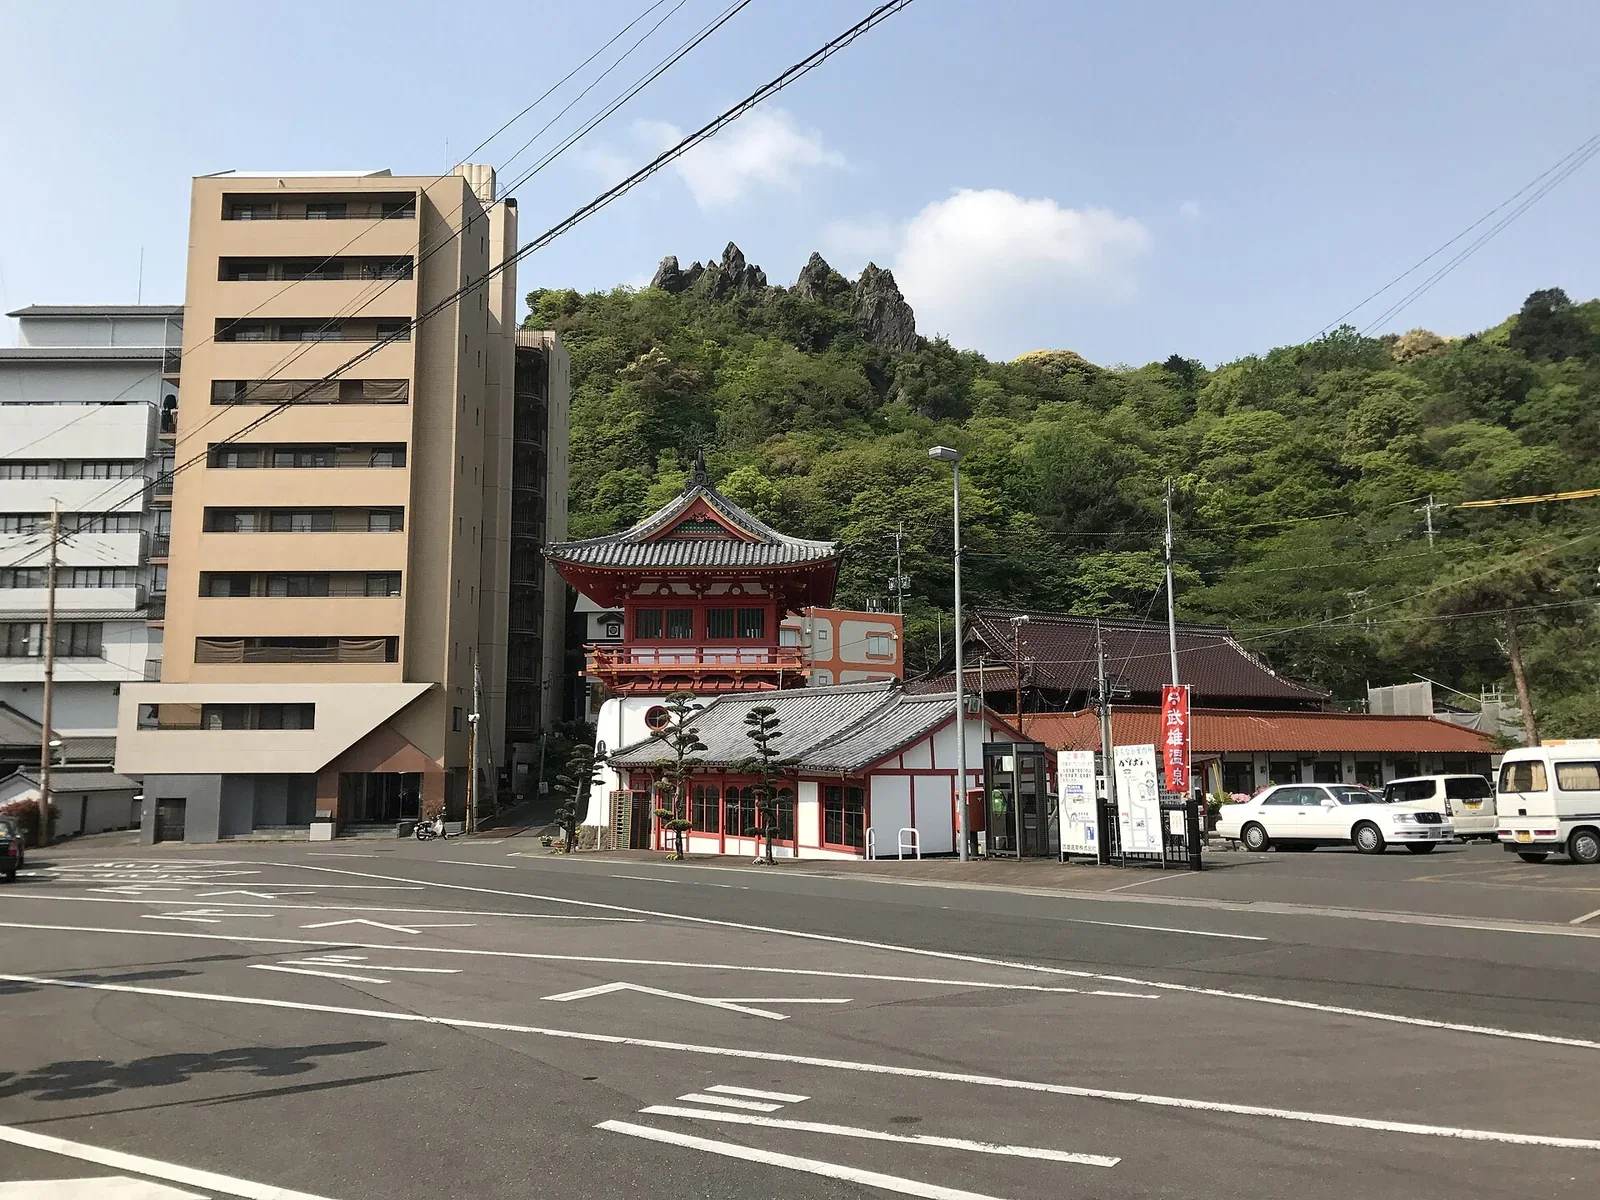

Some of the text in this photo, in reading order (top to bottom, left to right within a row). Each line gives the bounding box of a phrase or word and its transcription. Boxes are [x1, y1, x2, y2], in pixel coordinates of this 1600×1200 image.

[1118, 756, 1150, 767] がばい
[1166, 708, 1185, 787] 武雄温泉
[247, 954, 853, 1020] バス
